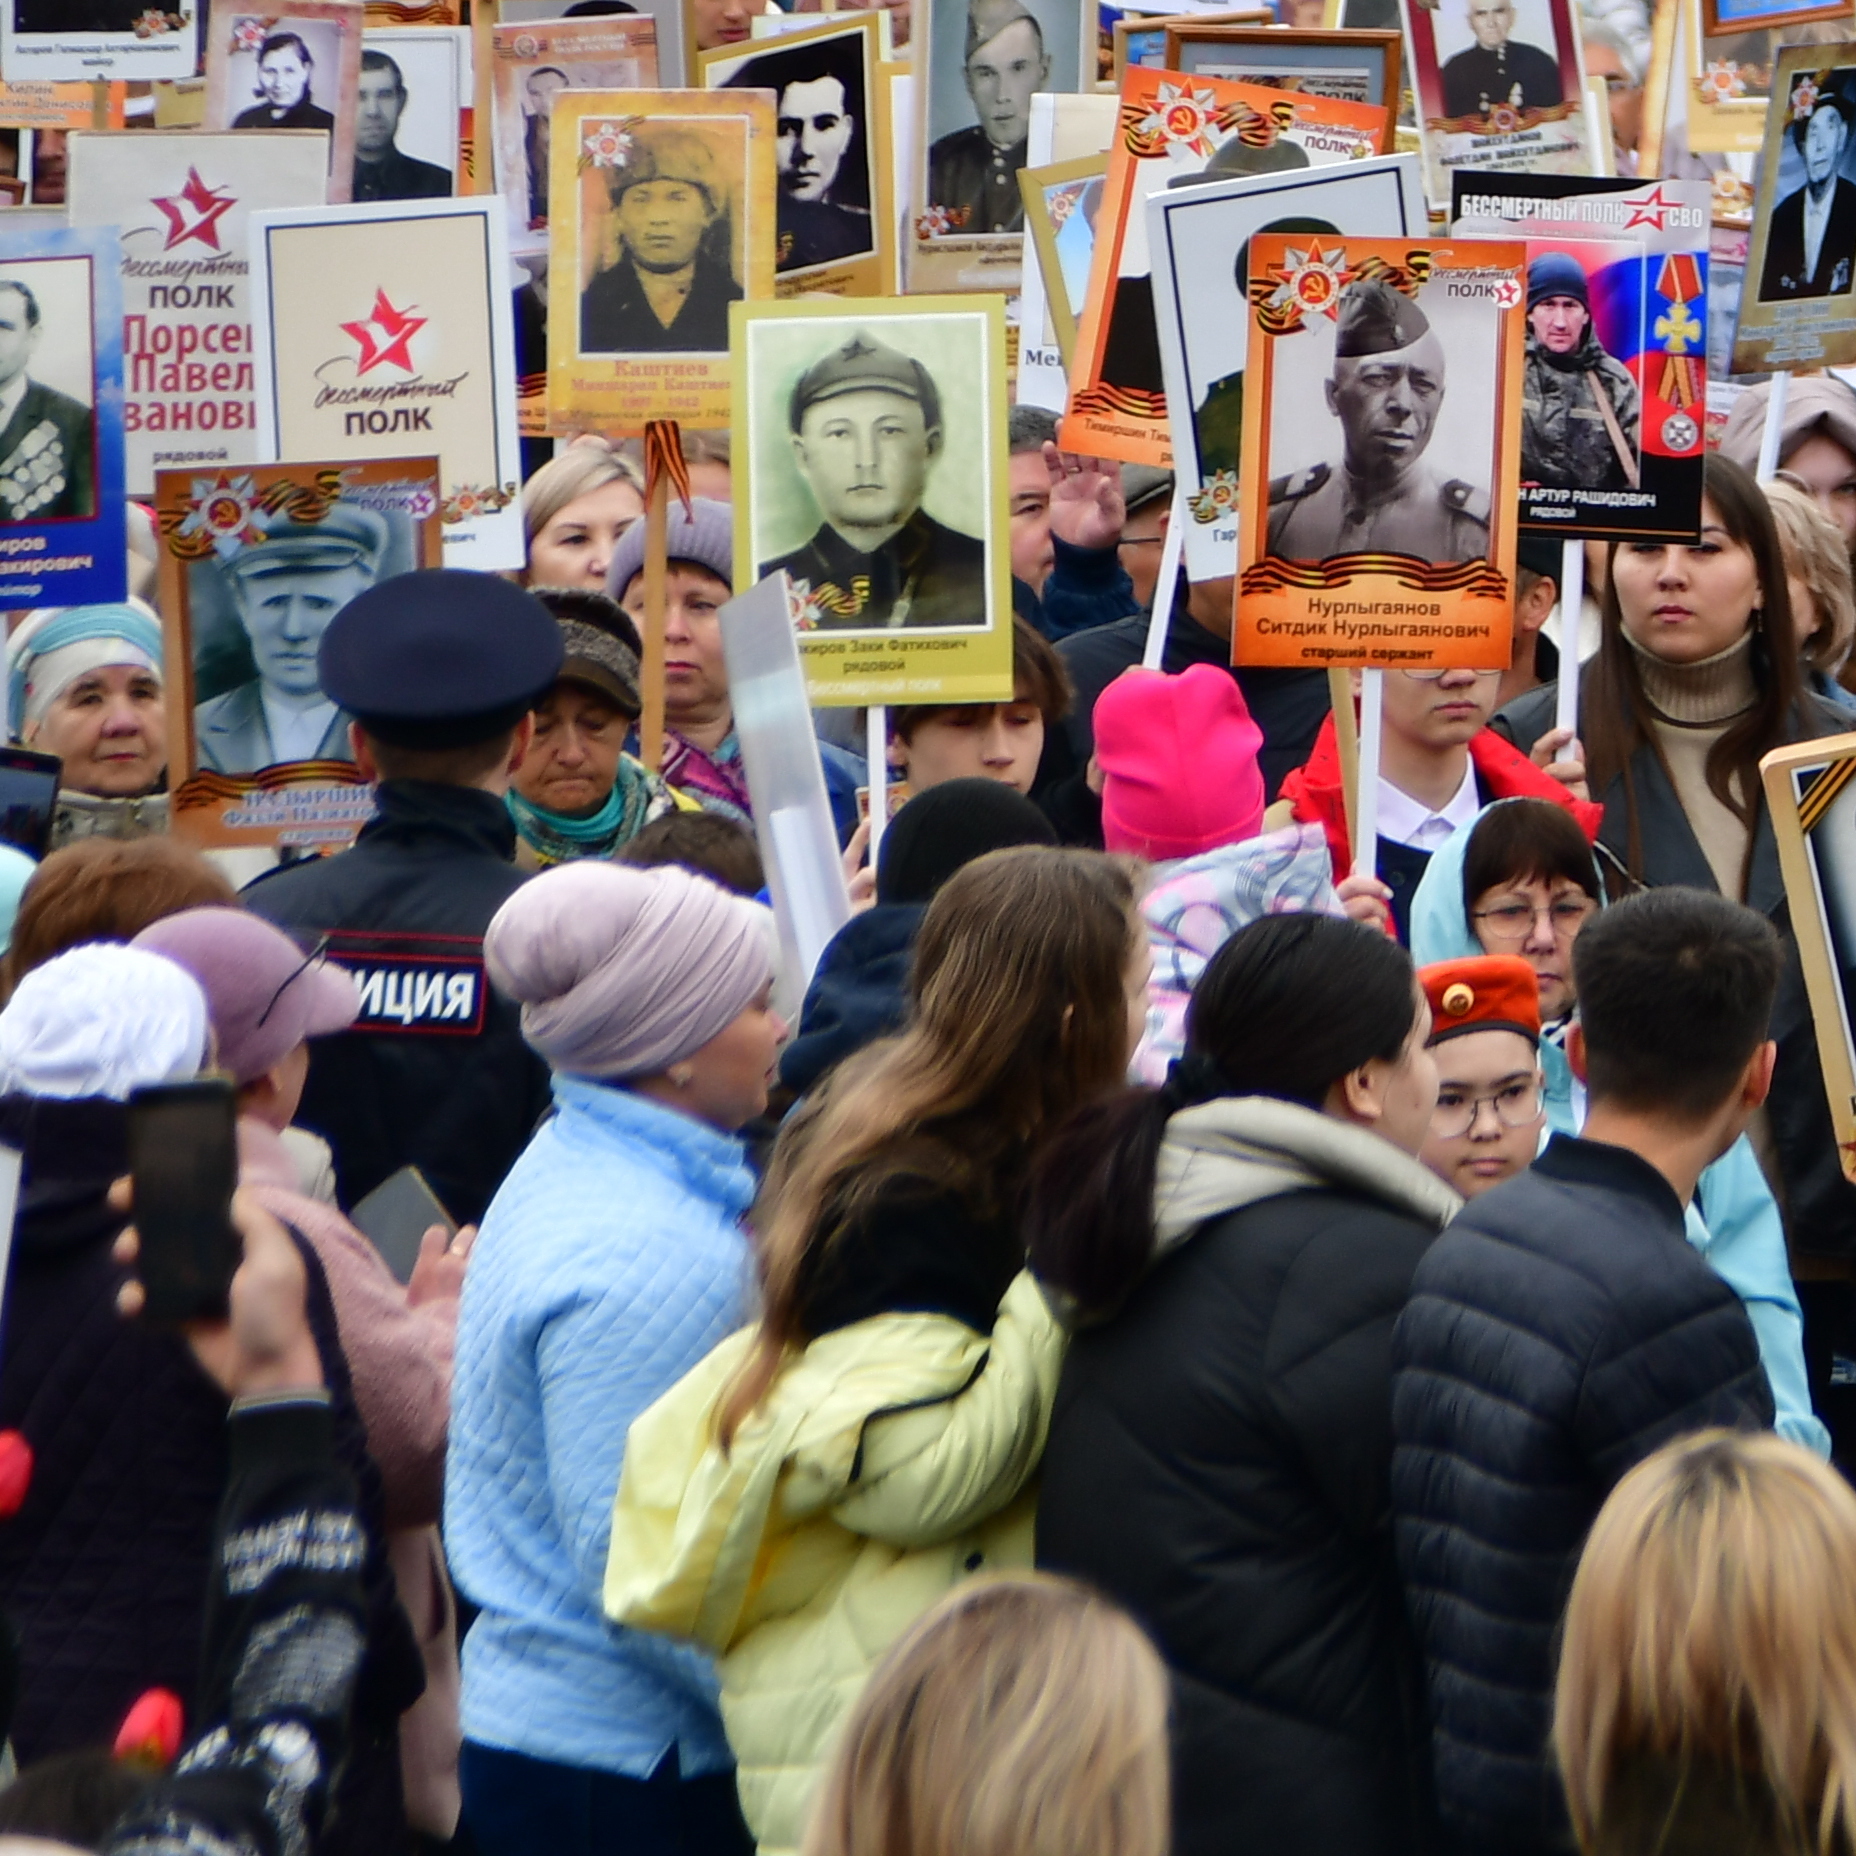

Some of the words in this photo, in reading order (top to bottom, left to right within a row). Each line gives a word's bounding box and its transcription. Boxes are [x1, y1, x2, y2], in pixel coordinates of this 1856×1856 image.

[1304, 134, 1352, 154] ПОЛК
[1460, 193, 1578, 220] БЕССМЕРТНЫЙ
[1581, 200, 1625, 223] ПОЛК
[1668, 207, 1703, 228] СВО
[149, 285, 237, 310] ПОЛК
[1447, 282, 1492, 298] ПОЛК
[131, 351, 256, 395] Павел
[313, 365, 470, 410] бессмертный
[344, 411, 433, 436] ПОЛК
[1082, 417, 1146, 439] Тимиршин
[152, 446, 229, 462] рядовой
[1529, 487, 1571, 506] АРТУР
[1572, 490, 1657, 511] РАШИДОВИЧ
[1308, 596, 1441, 619] Нурлыгаянов
[1256, 617, 1327, 640] Ситдик
[1332, 619, 1490, 642] Нурлыгаянович
[849, 639, 884, 654] Заки
[889, 637, 968, 653] Фатихович
[1301, 646, 1367, 663] старший
[1371, 647, 1434, 662] сержант
[842, 657, 906, 675] рядовой
[350, 969, 476, 1026] ИЦИЯ
